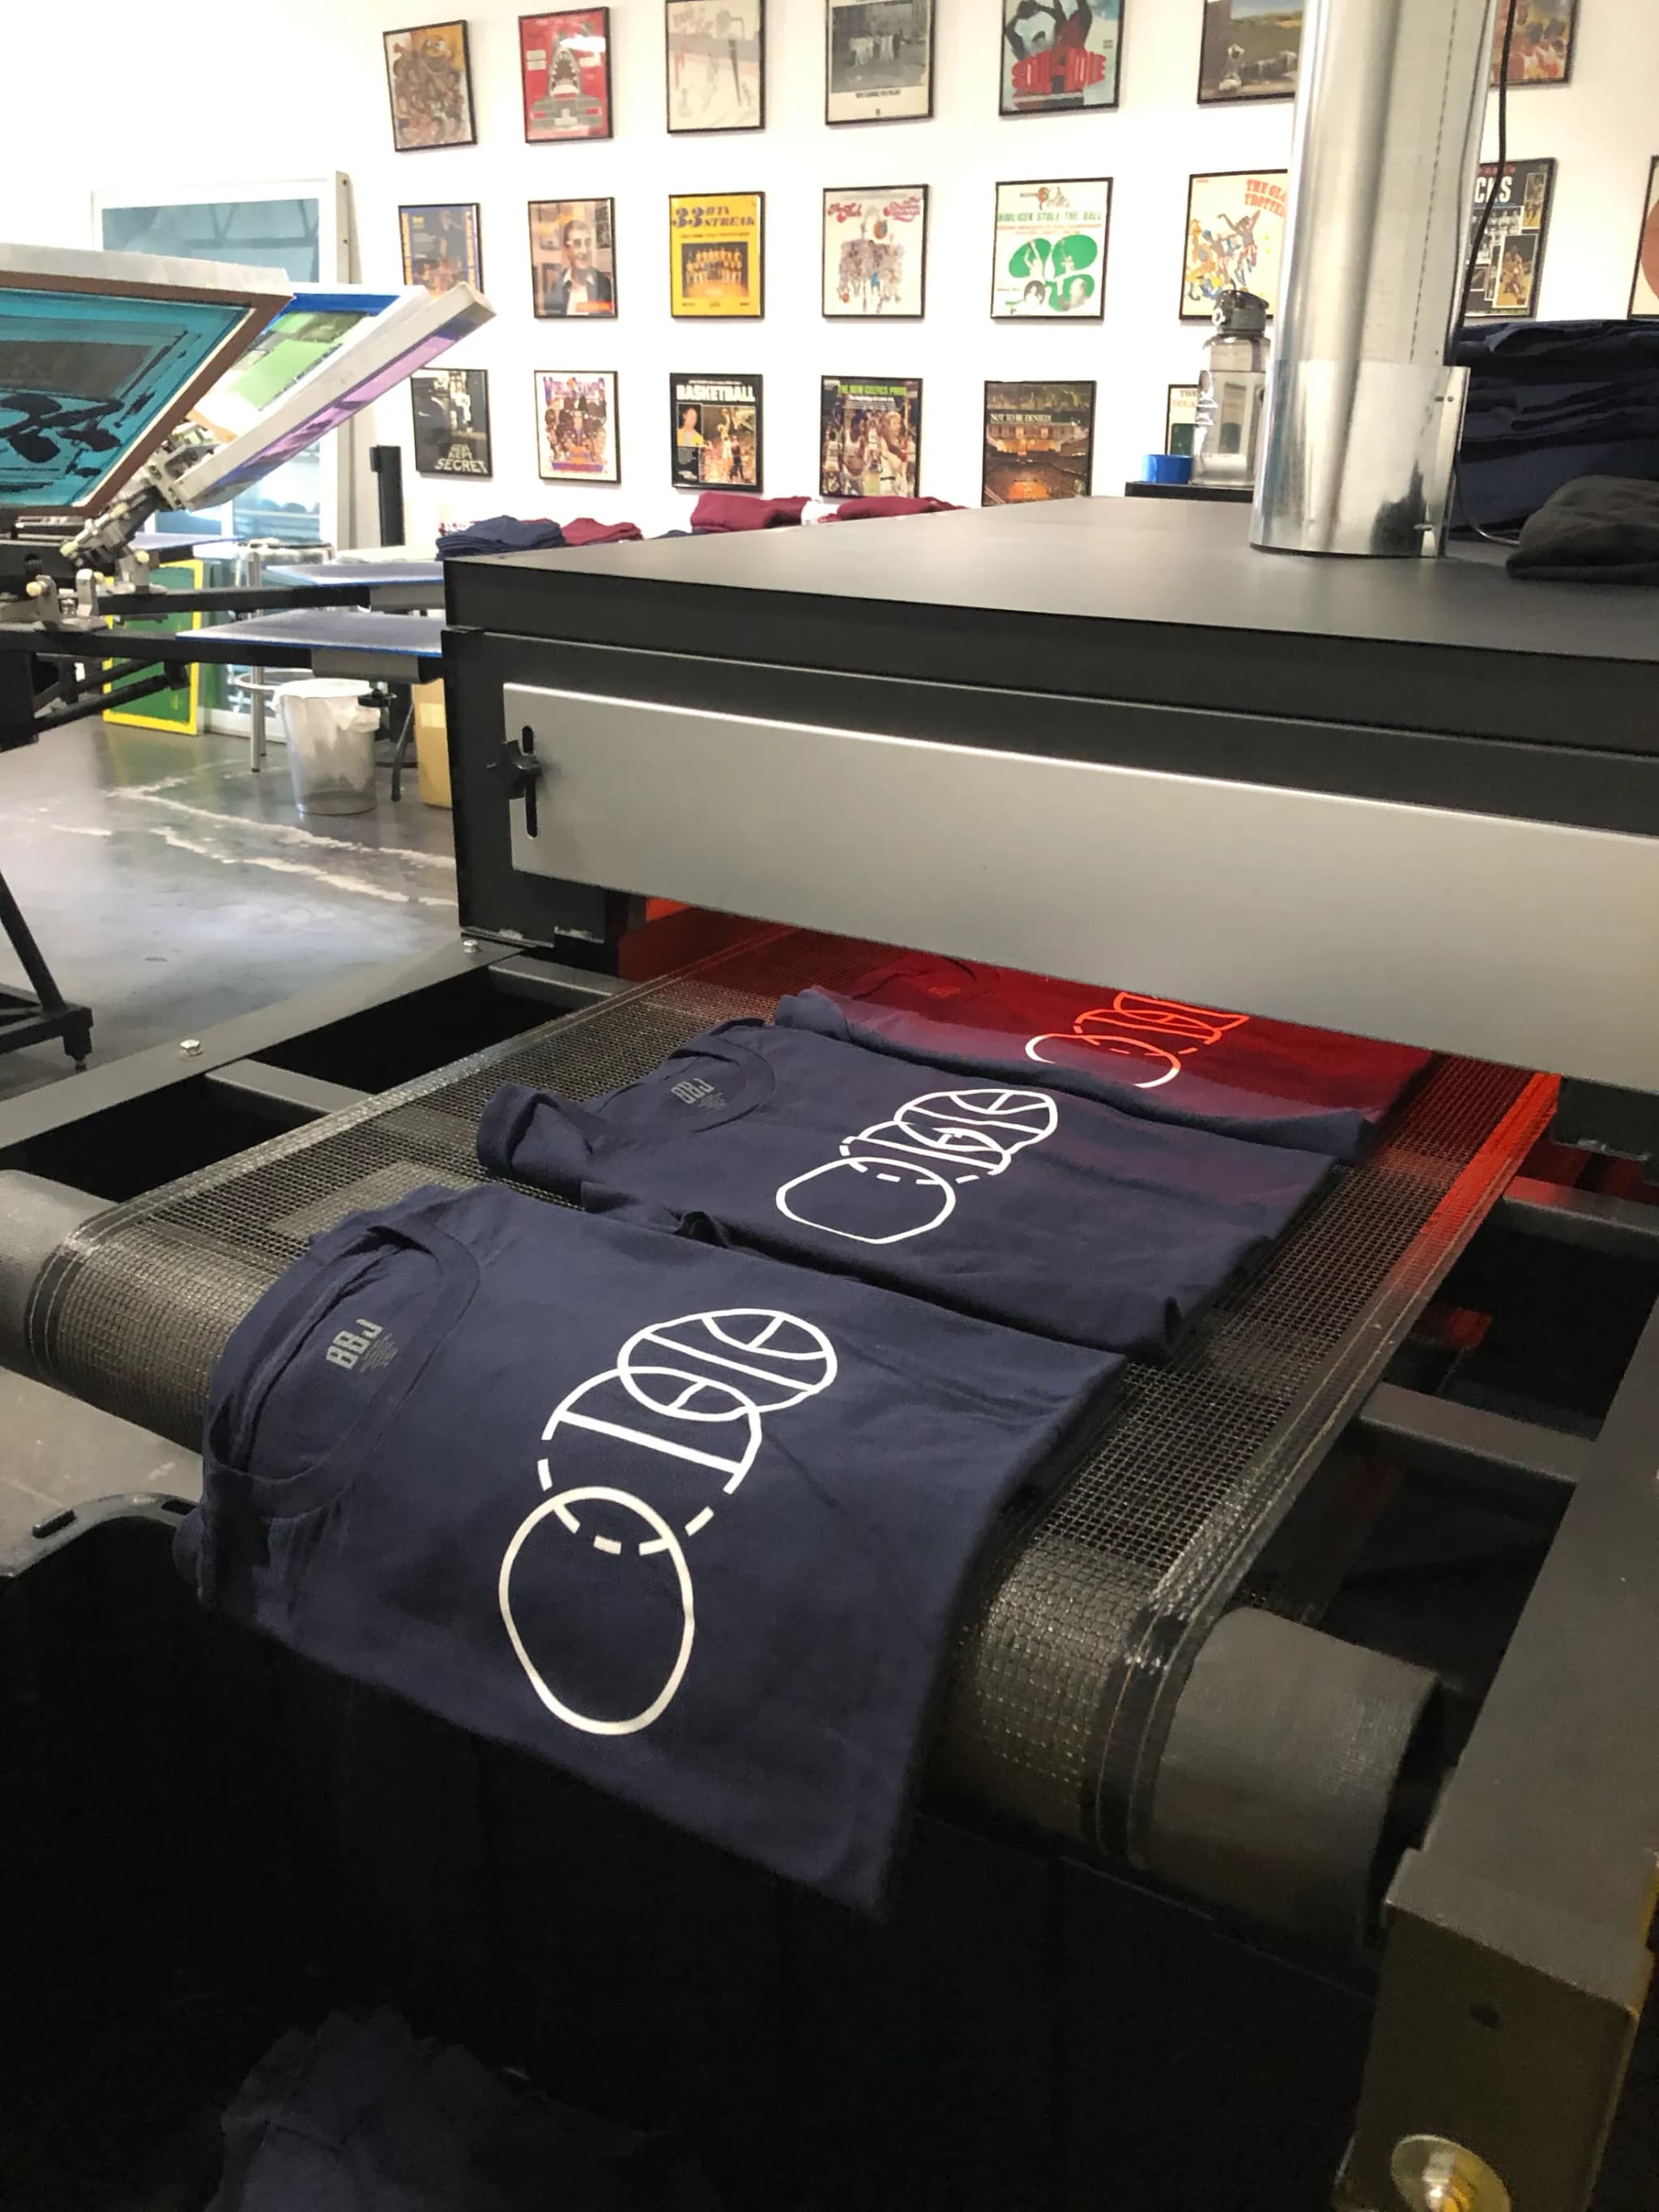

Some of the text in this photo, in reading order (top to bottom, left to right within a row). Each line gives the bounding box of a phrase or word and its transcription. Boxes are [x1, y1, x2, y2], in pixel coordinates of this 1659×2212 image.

[672, 206, 730, 228] 33 WIN
[676, 384, 756, 402] BASKETBALL
[435, 459, 488, 473] SECRET
